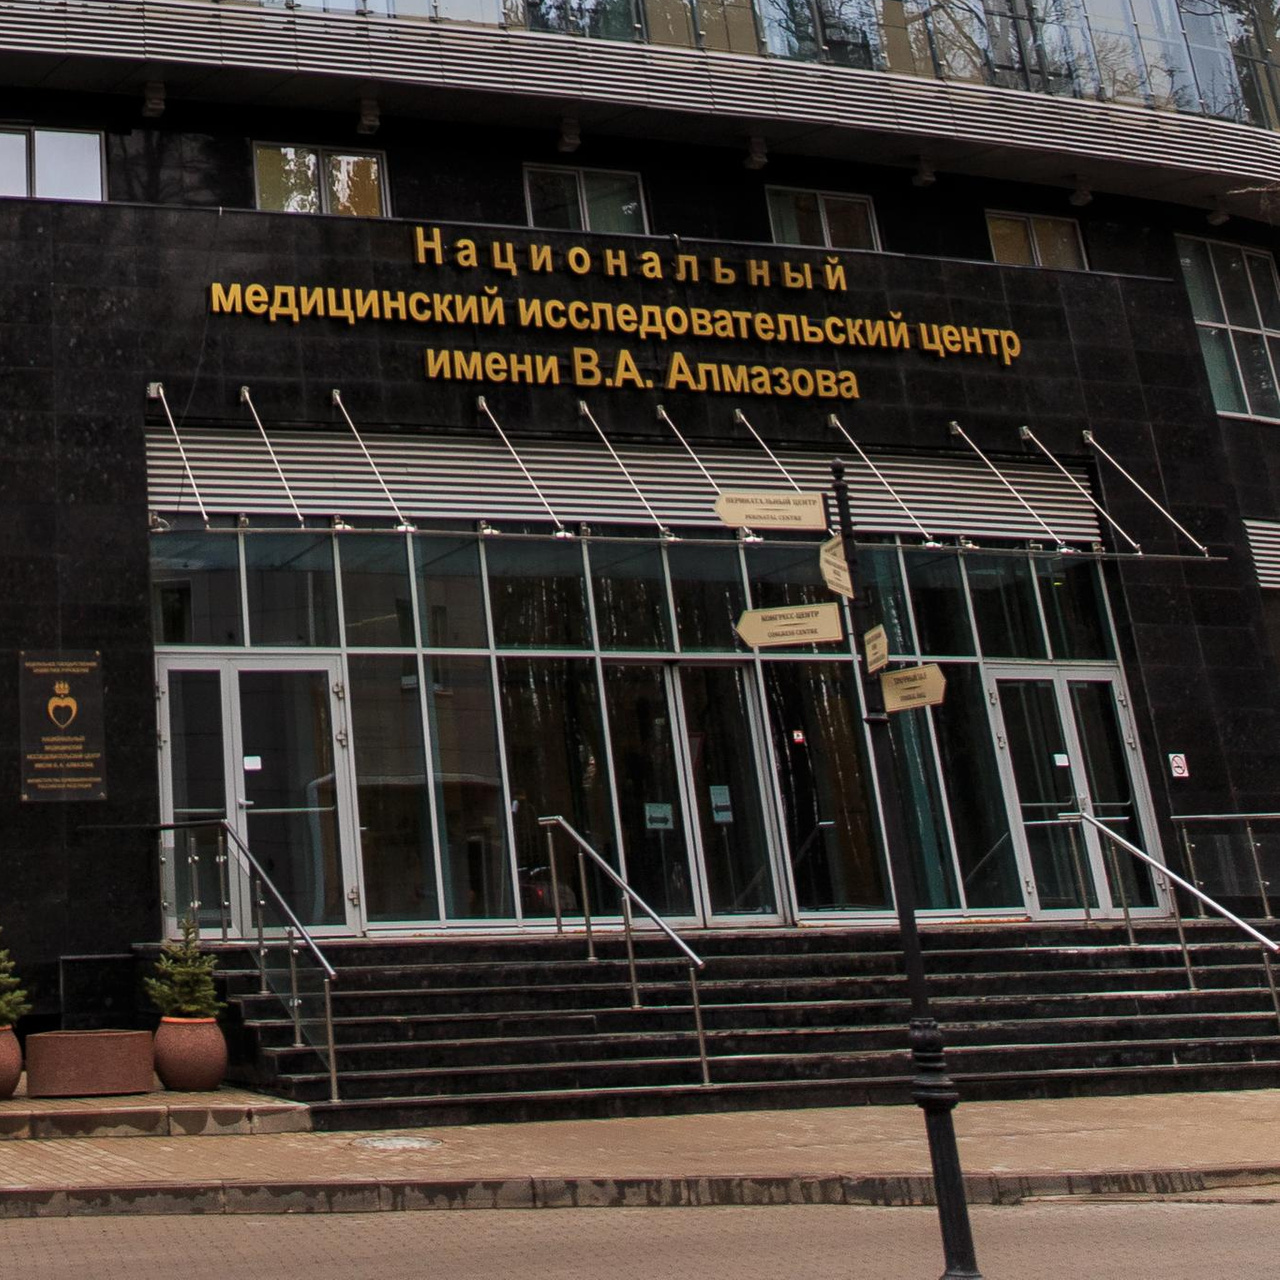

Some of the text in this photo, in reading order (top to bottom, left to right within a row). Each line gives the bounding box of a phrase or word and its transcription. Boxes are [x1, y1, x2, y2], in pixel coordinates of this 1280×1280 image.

[415, 226, 848, 291] Национальный
[210, 281, 1023, 366] медицинский исследовательский центр
[426, 346, 861, 400] имени В.А. Алмазова
[793, 499, 817, 507] ЦЕНТР
